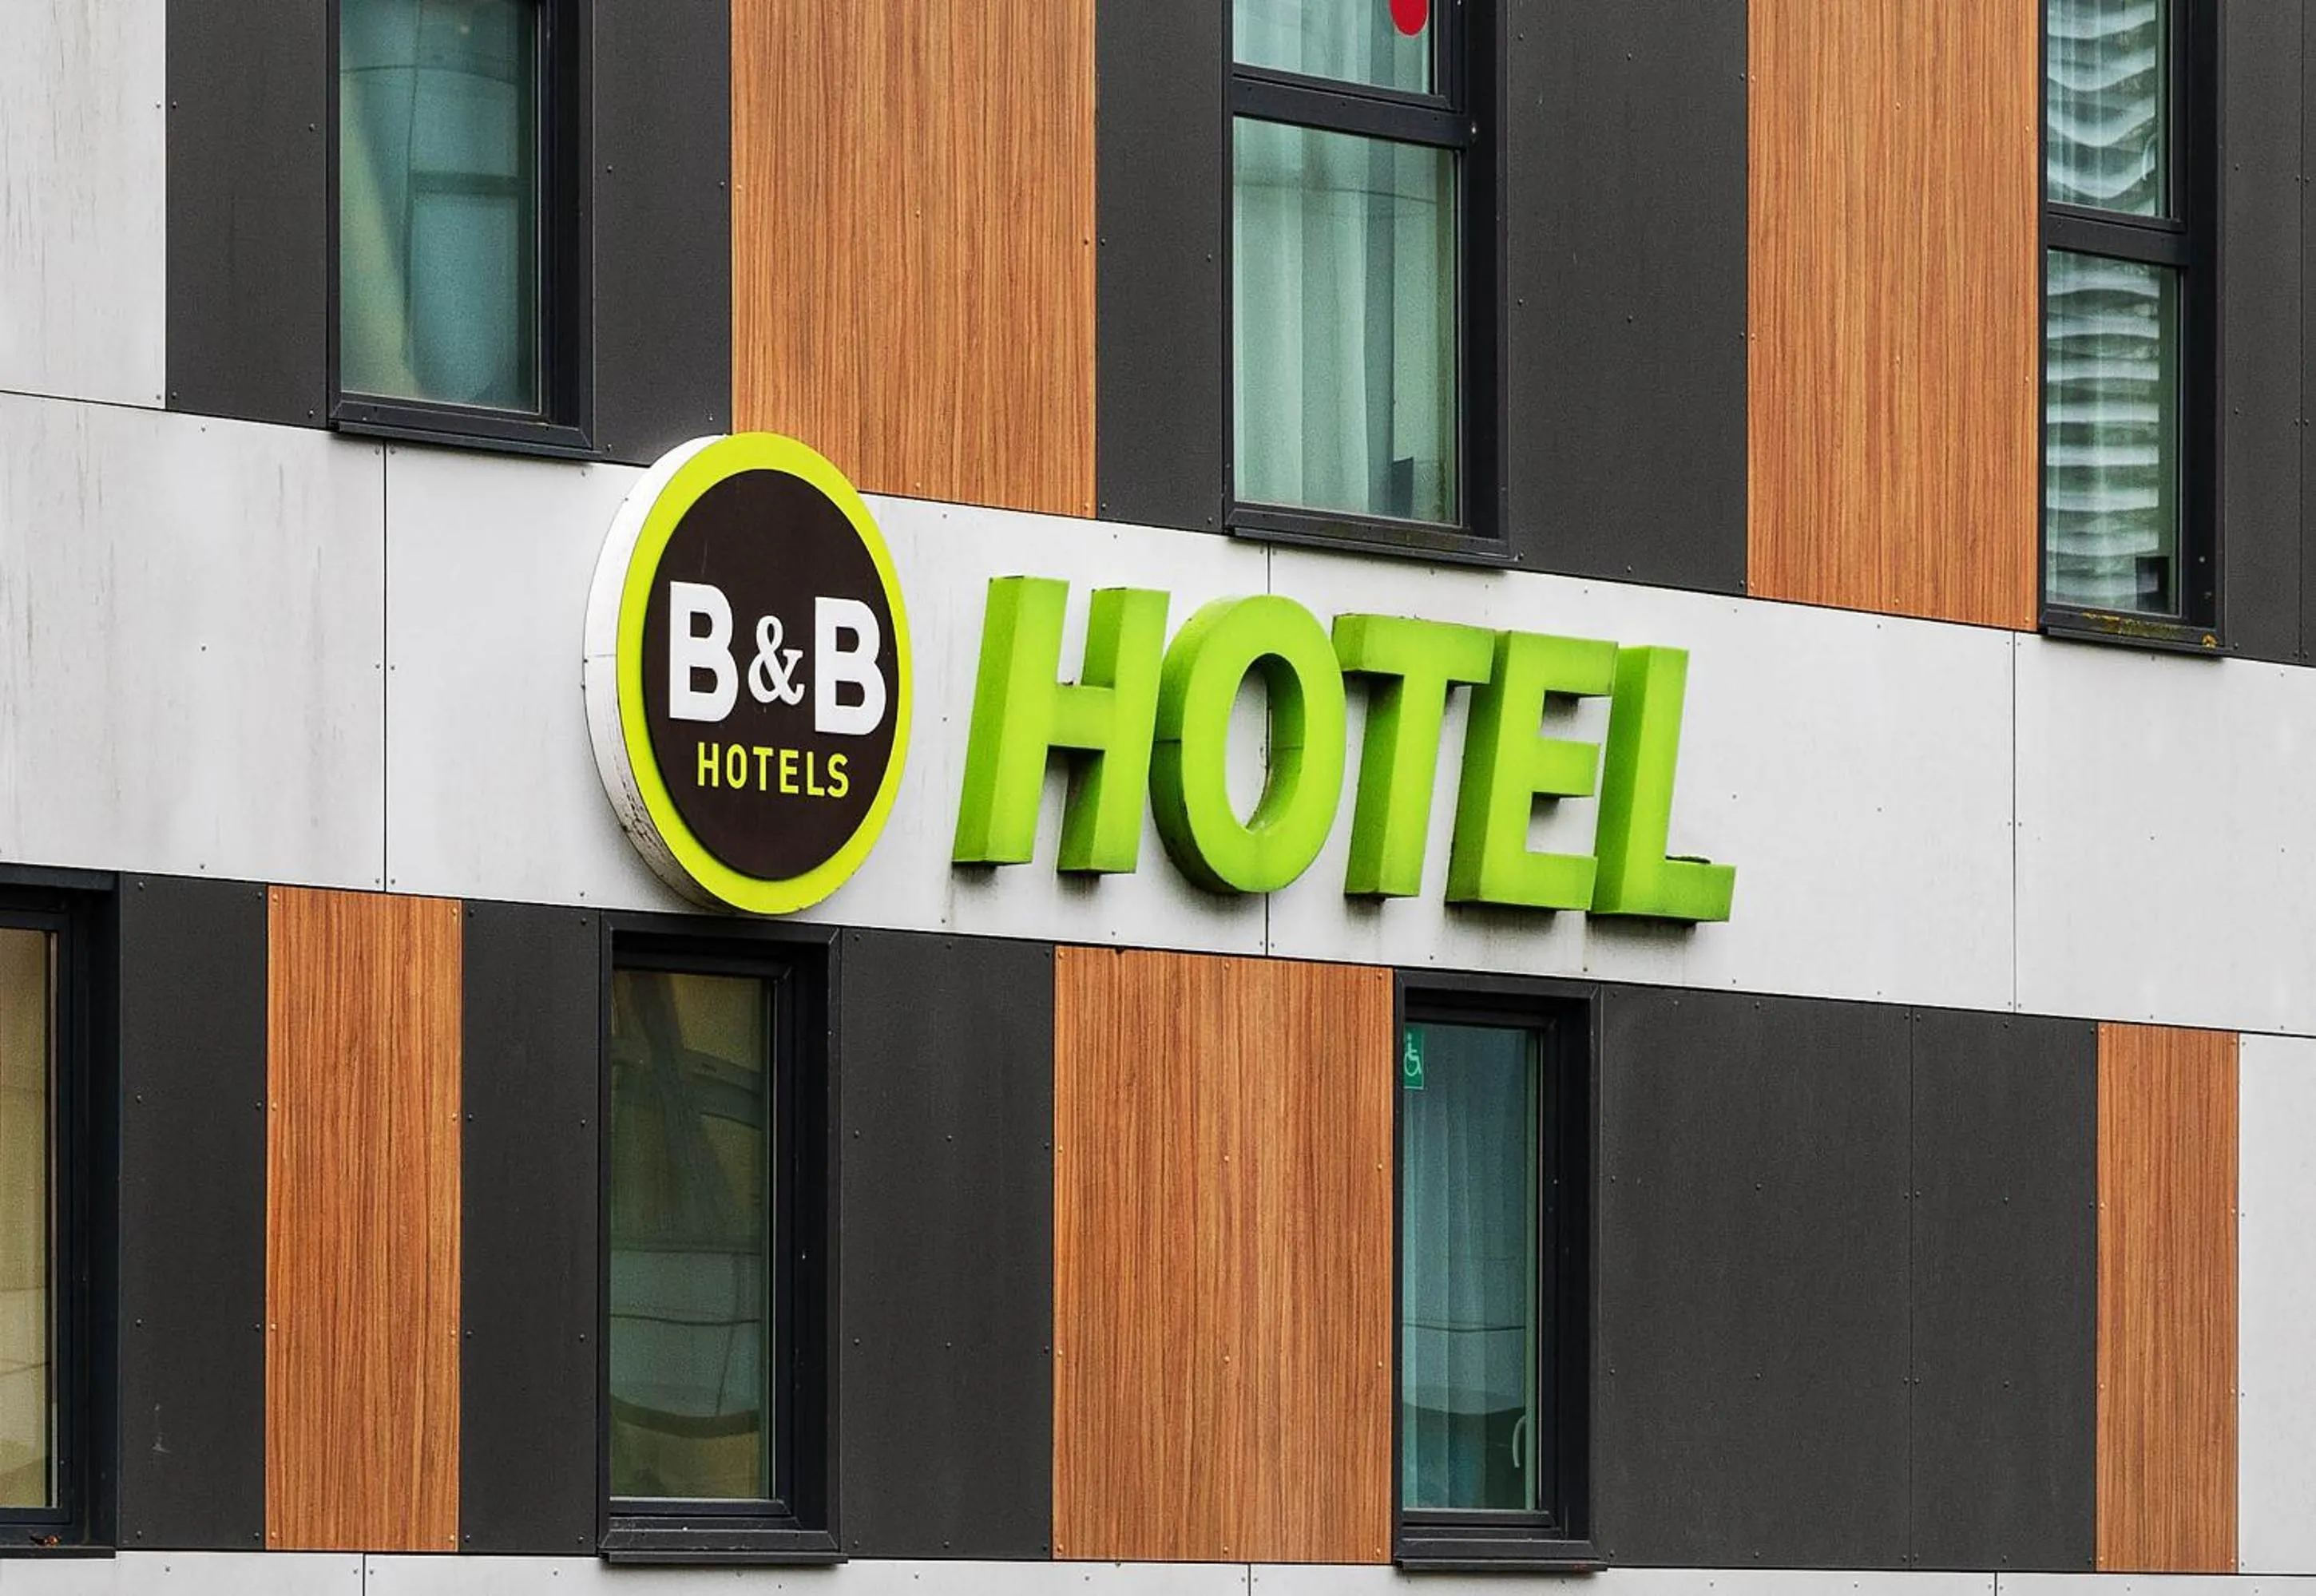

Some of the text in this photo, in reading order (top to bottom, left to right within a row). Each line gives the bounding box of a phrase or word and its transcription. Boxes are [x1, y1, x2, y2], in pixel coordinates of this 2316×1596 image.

[668, 580, 887, 735] B&B
[696, 741, 851, 798] HOTELS
[953, 576, 1736, 922] HOTEL
